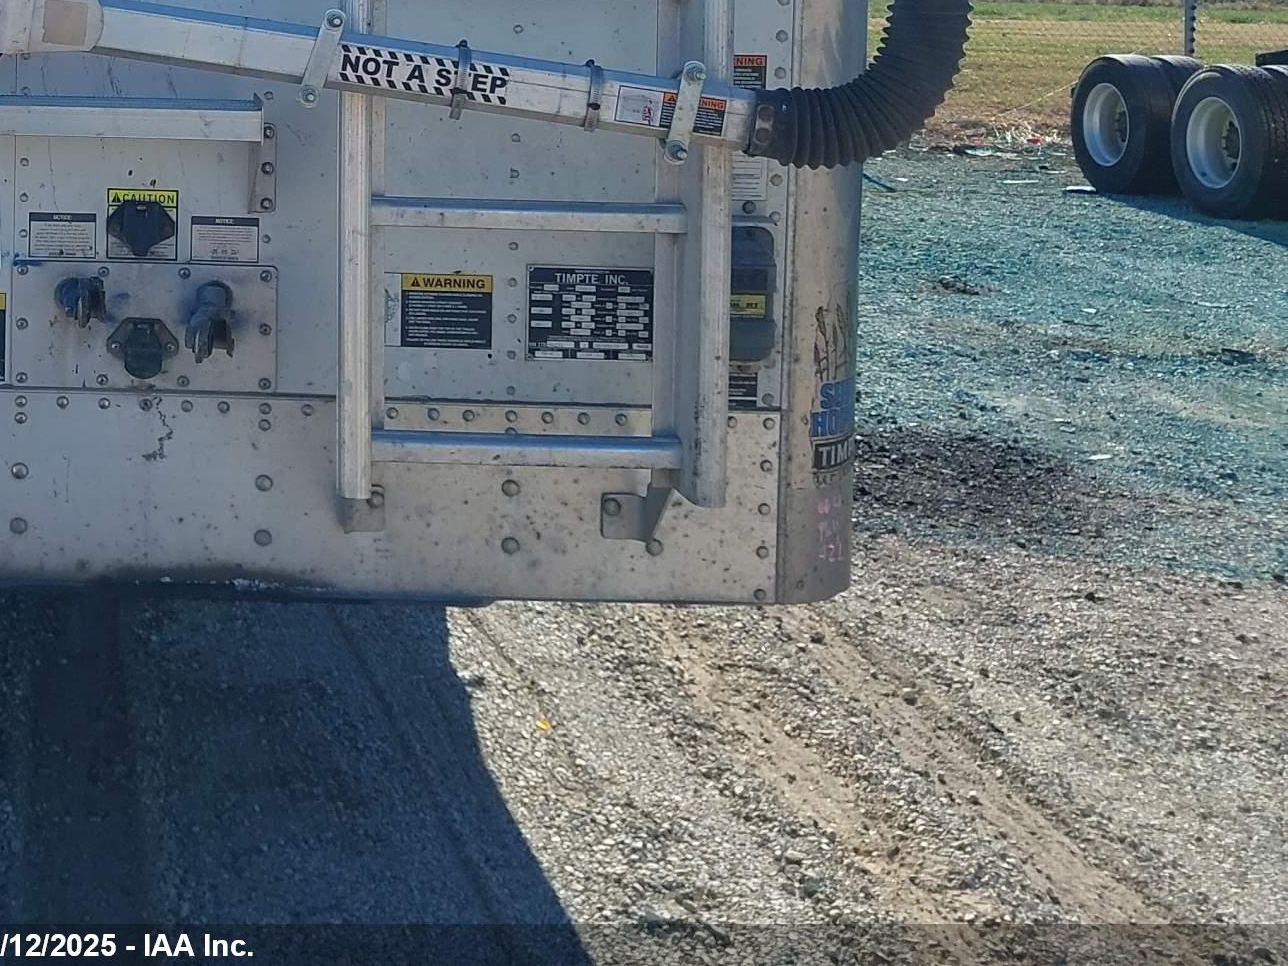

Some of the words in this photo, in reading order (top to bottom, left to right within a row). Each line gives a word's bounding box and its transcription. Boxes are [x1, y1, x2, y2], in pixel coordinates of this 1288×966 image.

[735, 56, 764, 67] NING
[341, 53, 400, 79] NOT
[406, 64, 426, 84] A
[434, 68, 508, 95] SEP
[122, 193, 175, 205] CAUTION
[423, 277, 486, 289] WARNING
[554, 273, 600, 284] TIMPTE
[604, 274, 630, 285] INC.
